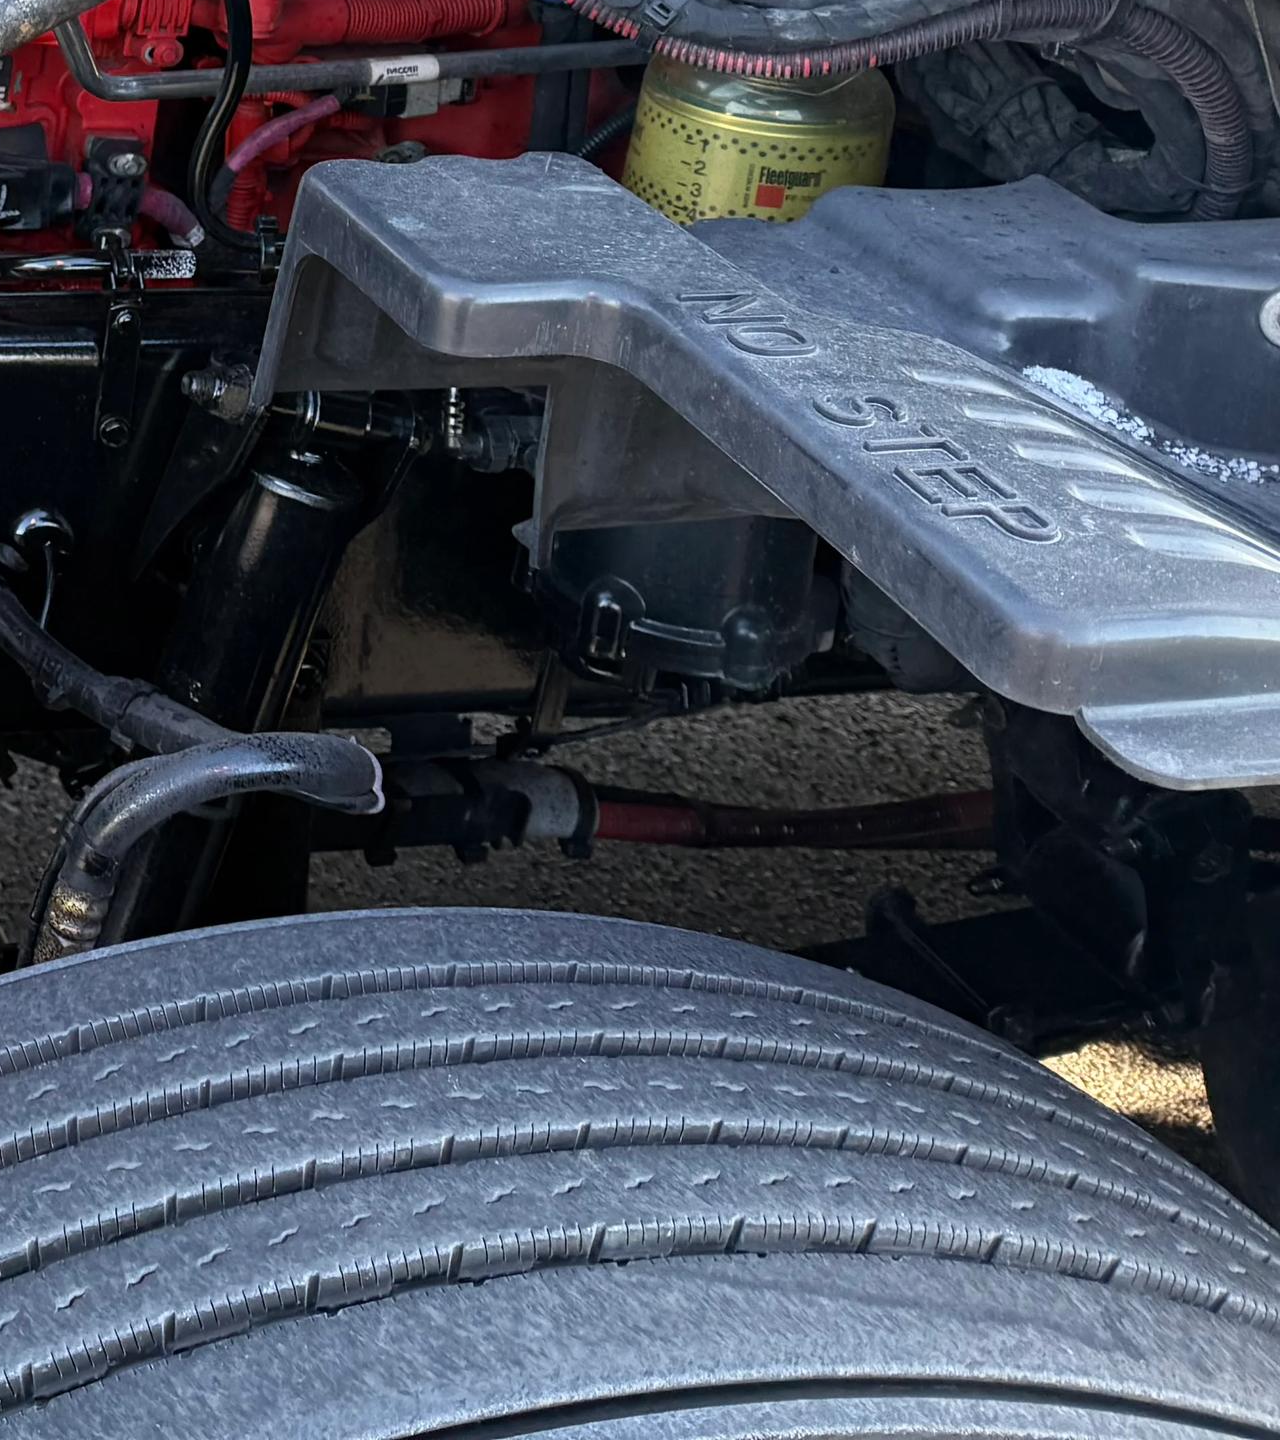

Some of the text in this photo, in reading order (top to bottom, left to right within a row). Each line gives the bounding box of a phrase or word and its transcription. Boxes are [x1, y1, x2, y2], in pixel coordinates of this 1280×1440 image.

[758, 165, 822, 190] Fleetguard
[676, 290, 819, 358] NO
[812, 394, 1063, 544] STEP
